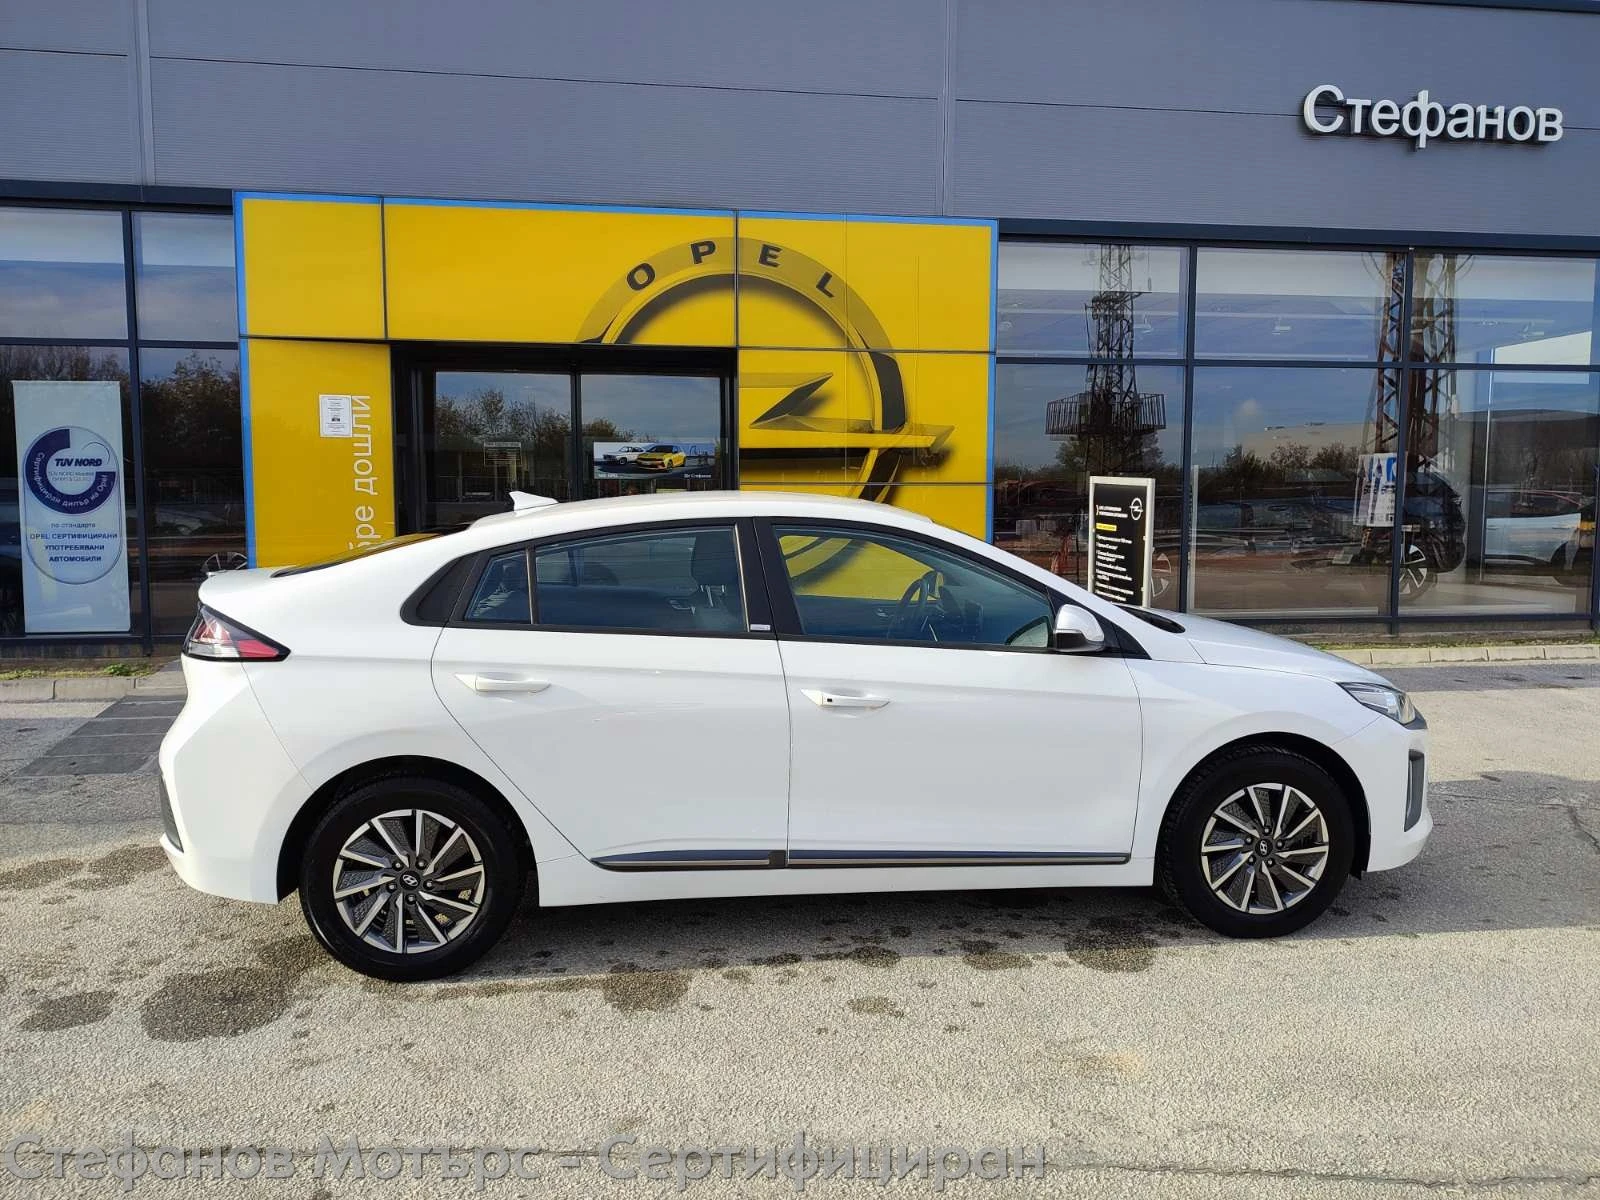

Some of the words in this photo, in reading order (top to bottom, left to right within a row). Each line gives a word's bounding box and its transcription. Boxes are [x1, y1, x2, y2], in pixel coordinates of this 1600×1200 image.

[1303, 84, 1564, 149] Стефанов
[626, 240, 836, 299] OPEL
[74, 458, 103, 467] NORD
[351, 395, 379, 496] дошли
[51, 532, 118, 540] СЕРТИФИЦИРАНИ
